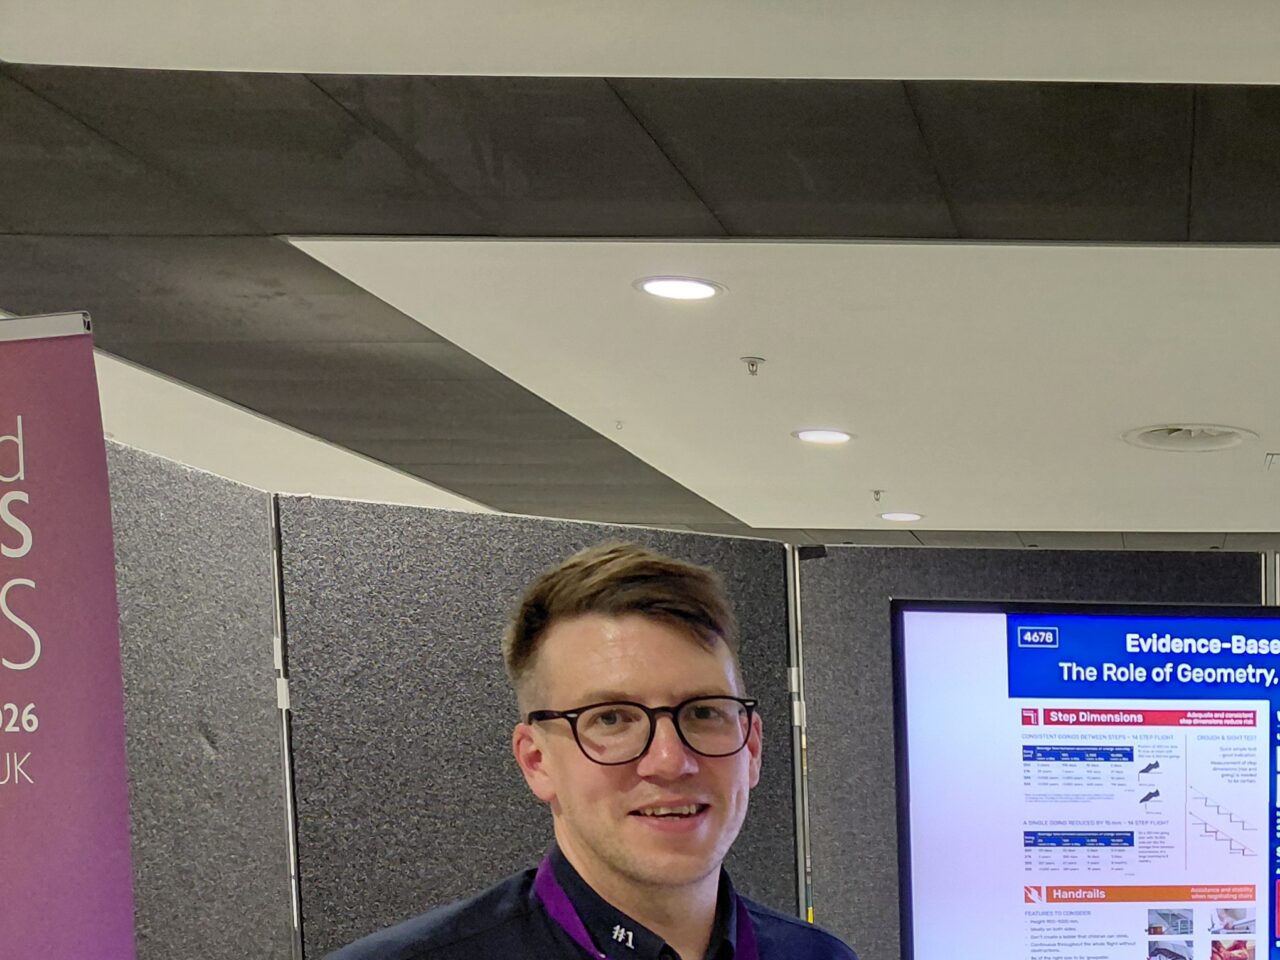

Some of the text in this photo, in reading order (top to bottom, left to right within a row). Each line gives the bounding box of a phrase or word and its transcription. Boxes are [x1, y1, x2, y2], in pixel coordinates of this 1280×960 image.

[0, 491, 33, 558] S
[1, 578, 41, 670] S
[1023, 631, 1054, 643] 4678
[1058, 662, 1098, 682] The
[1102, 662, 1147, 682] Role
[1151, 663, 1174, 682] of
[1176, 663, 1279, 688] Geometry,
[0, 703, 39, 732] 26
[1049, 711, 1144, 724] Step Dimensions
[1053, 889, 1106, 900] Handrails
[612, 925, 634, 949] #1
